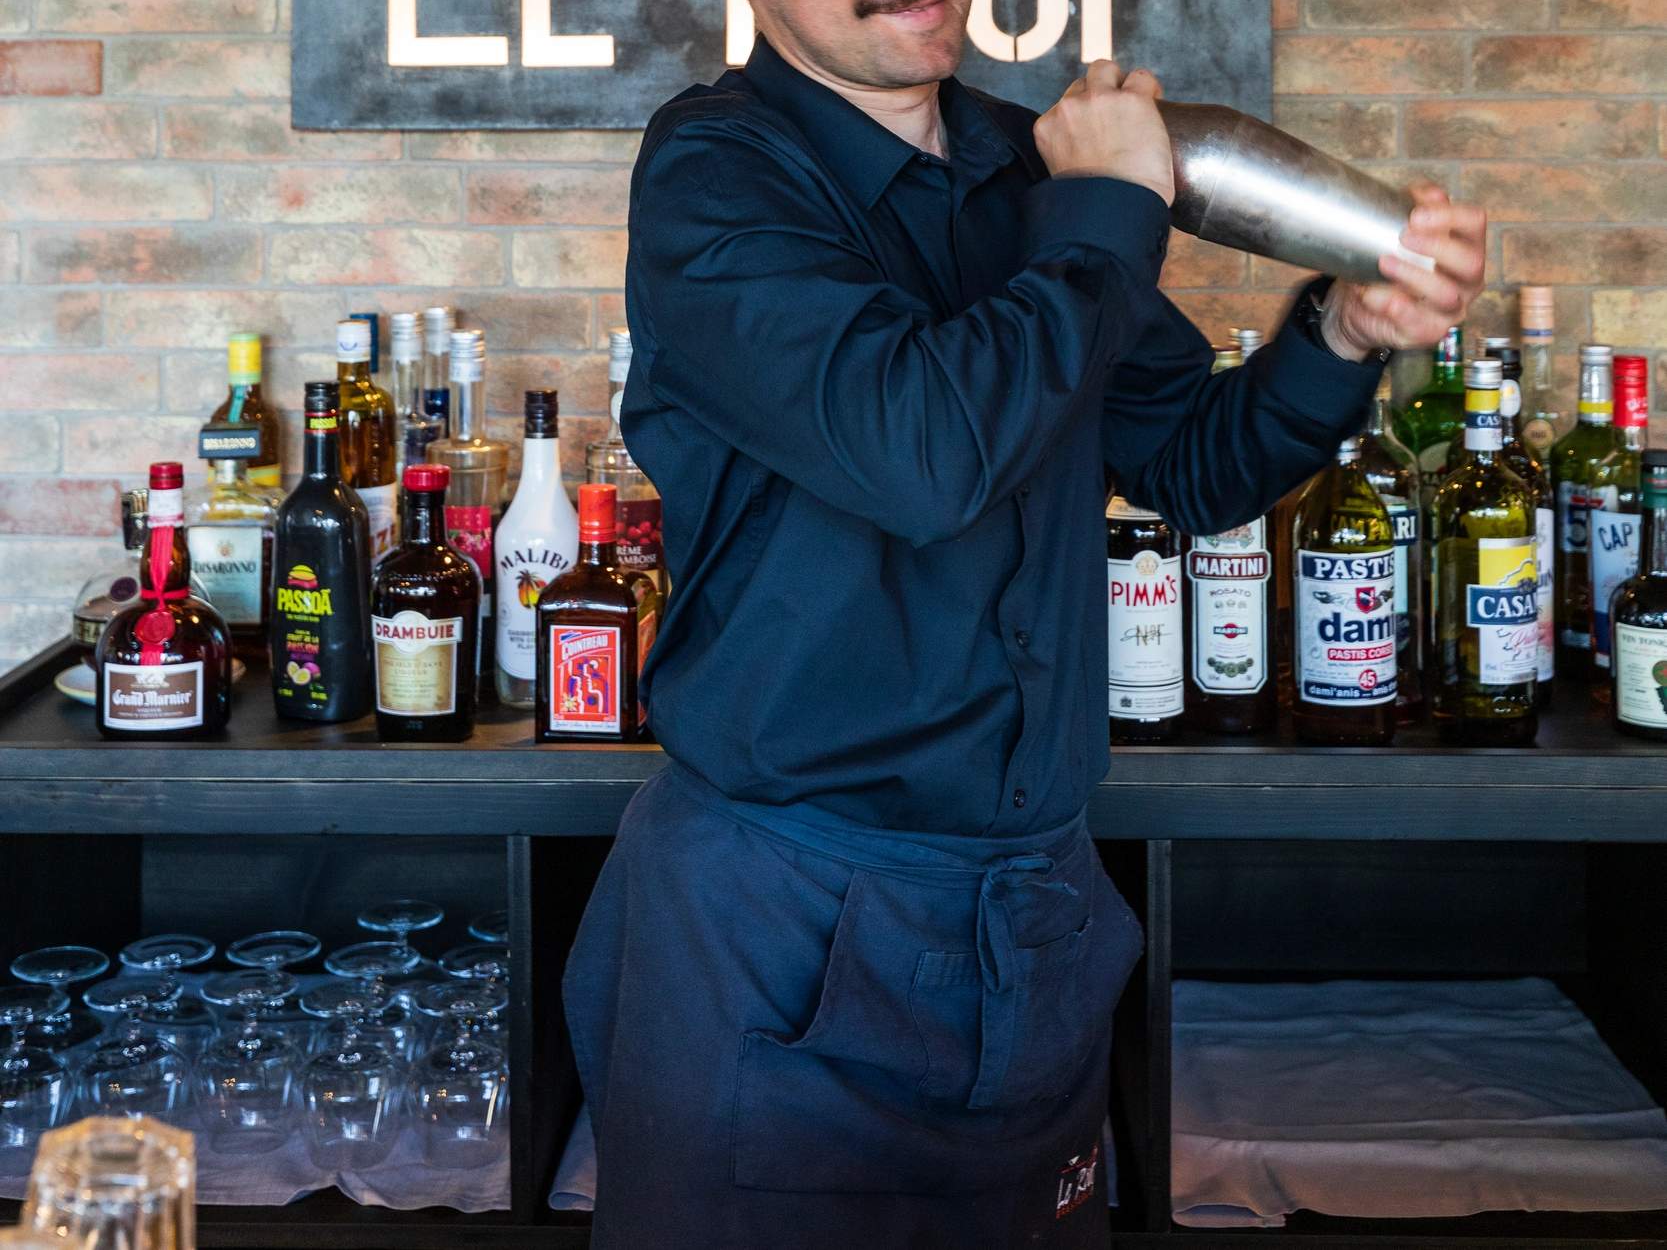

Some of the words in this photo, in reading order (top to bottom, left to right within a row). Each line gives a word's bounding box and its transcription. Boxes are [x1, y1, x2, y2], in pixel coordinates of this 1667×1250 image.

[1597, 522, 1633, 552] CAP
[1195, 557, 1264, 577] MARTINI
[1110, 574, 1178, 608] PIMM'S
[1476, 594, 1537, 619] CASA
[375, 622, 455, 640] DRAMBUIE
[1329, 649, 1366, 660] PASTIS
[1360, 671, 1375, 687] 45
[111, 688, 144, 707] Grand
[143, 689, 192, 708] Marnier
